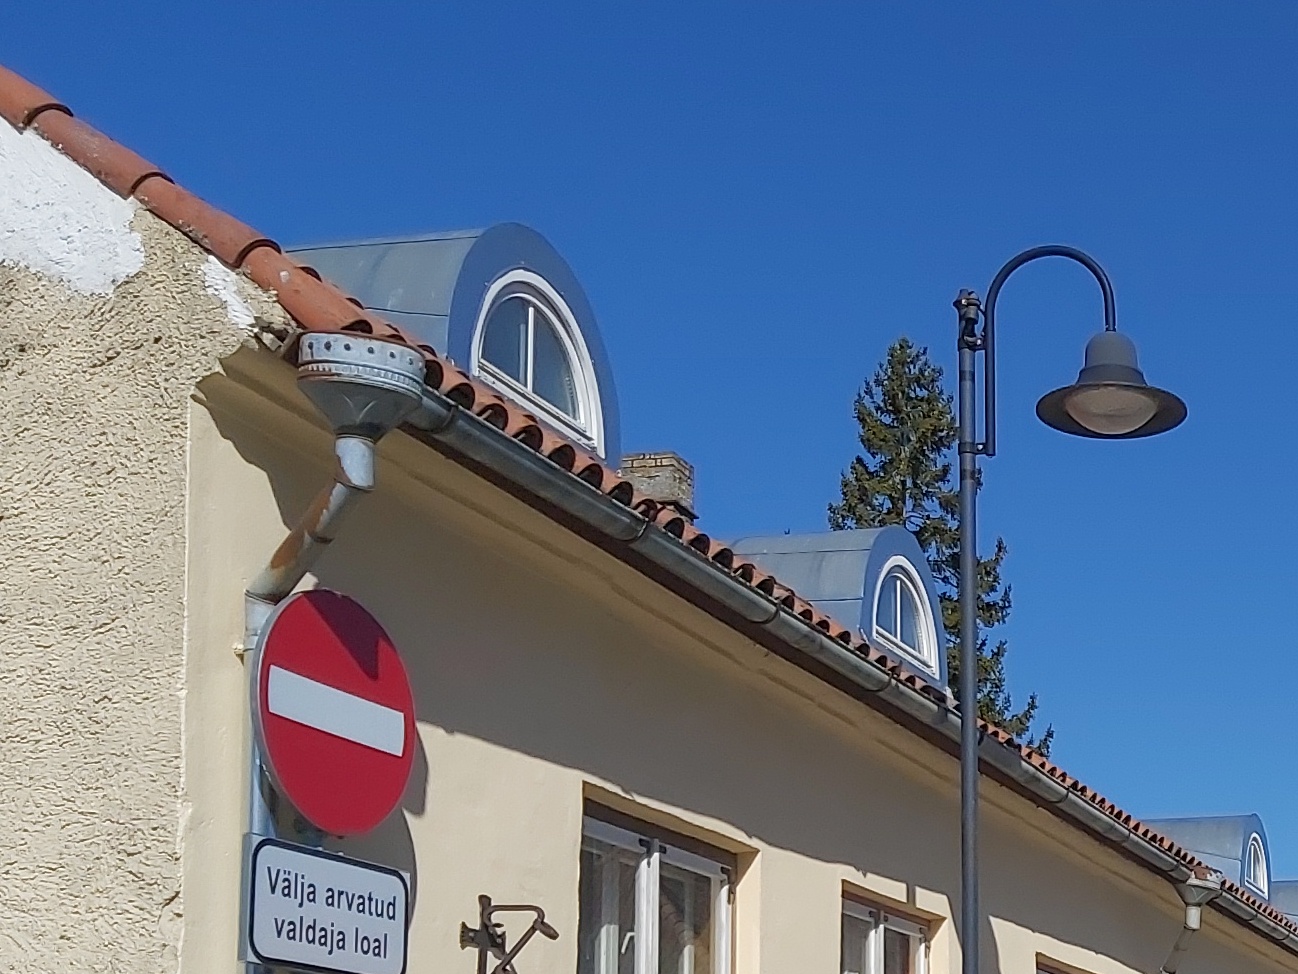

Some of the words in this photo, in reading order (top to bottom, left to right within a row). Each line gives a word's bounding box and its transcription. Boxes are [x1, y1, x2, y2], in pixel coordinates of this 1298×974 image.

[267, 866, 316, 908] Välja
[325, 887, 396, 921] arvatud
[274, 916, 346, 955] valdaja
[354, 927, 388, 959] loal
